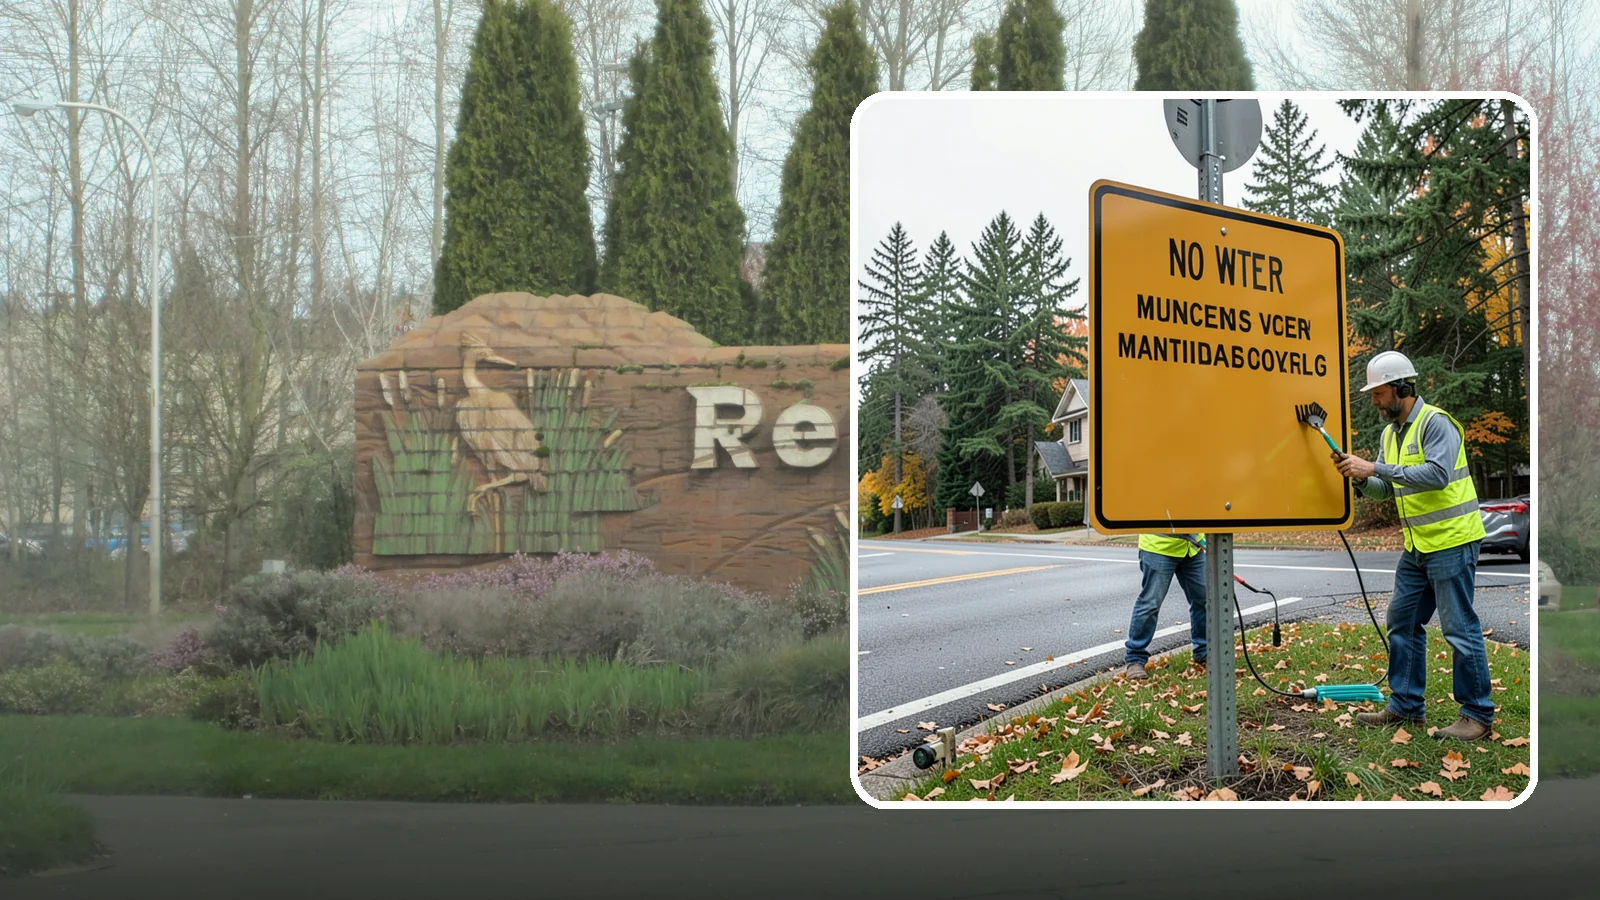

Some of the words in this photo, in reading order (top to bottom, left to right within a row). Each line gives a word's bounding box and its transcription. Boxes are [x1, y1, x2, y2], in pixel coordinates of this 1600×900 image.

[1169, 237, 1204, 281] NO
[1215, 245, 1284, 294] WTER
[1137, 294, 1251, 333] MUNCENS
